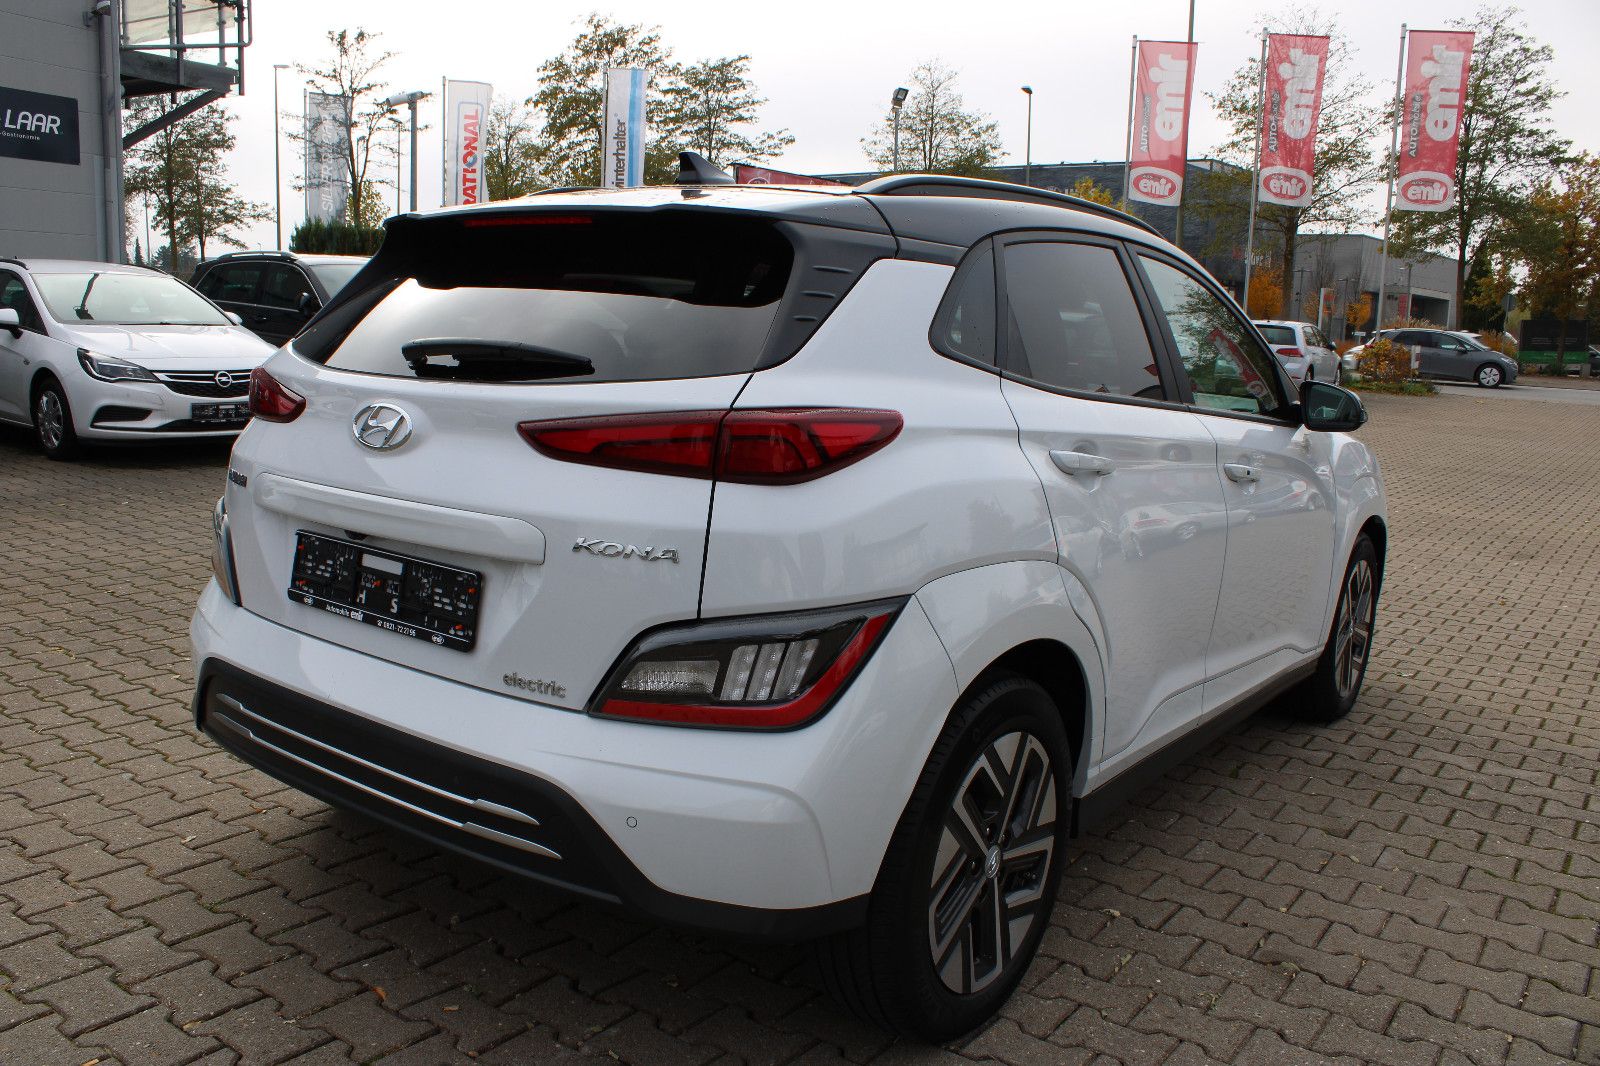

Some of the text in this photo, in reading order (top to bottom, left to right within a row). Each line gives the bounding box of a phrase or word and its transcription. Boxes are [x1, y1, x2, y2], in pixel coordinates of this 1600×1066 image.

[1149, 53, 1188, 141] emir
[1278, 48, 1319, 140] emir
[1421, 44, 1465, 142] emir
[4, 108, 61, 135] LAAR
[1139, 178, 1171, 196] emir
[1407, 182, 1446, 201] emir
[572, 537, 680, 564] KONA
[502, 672, 567, 699] electric
